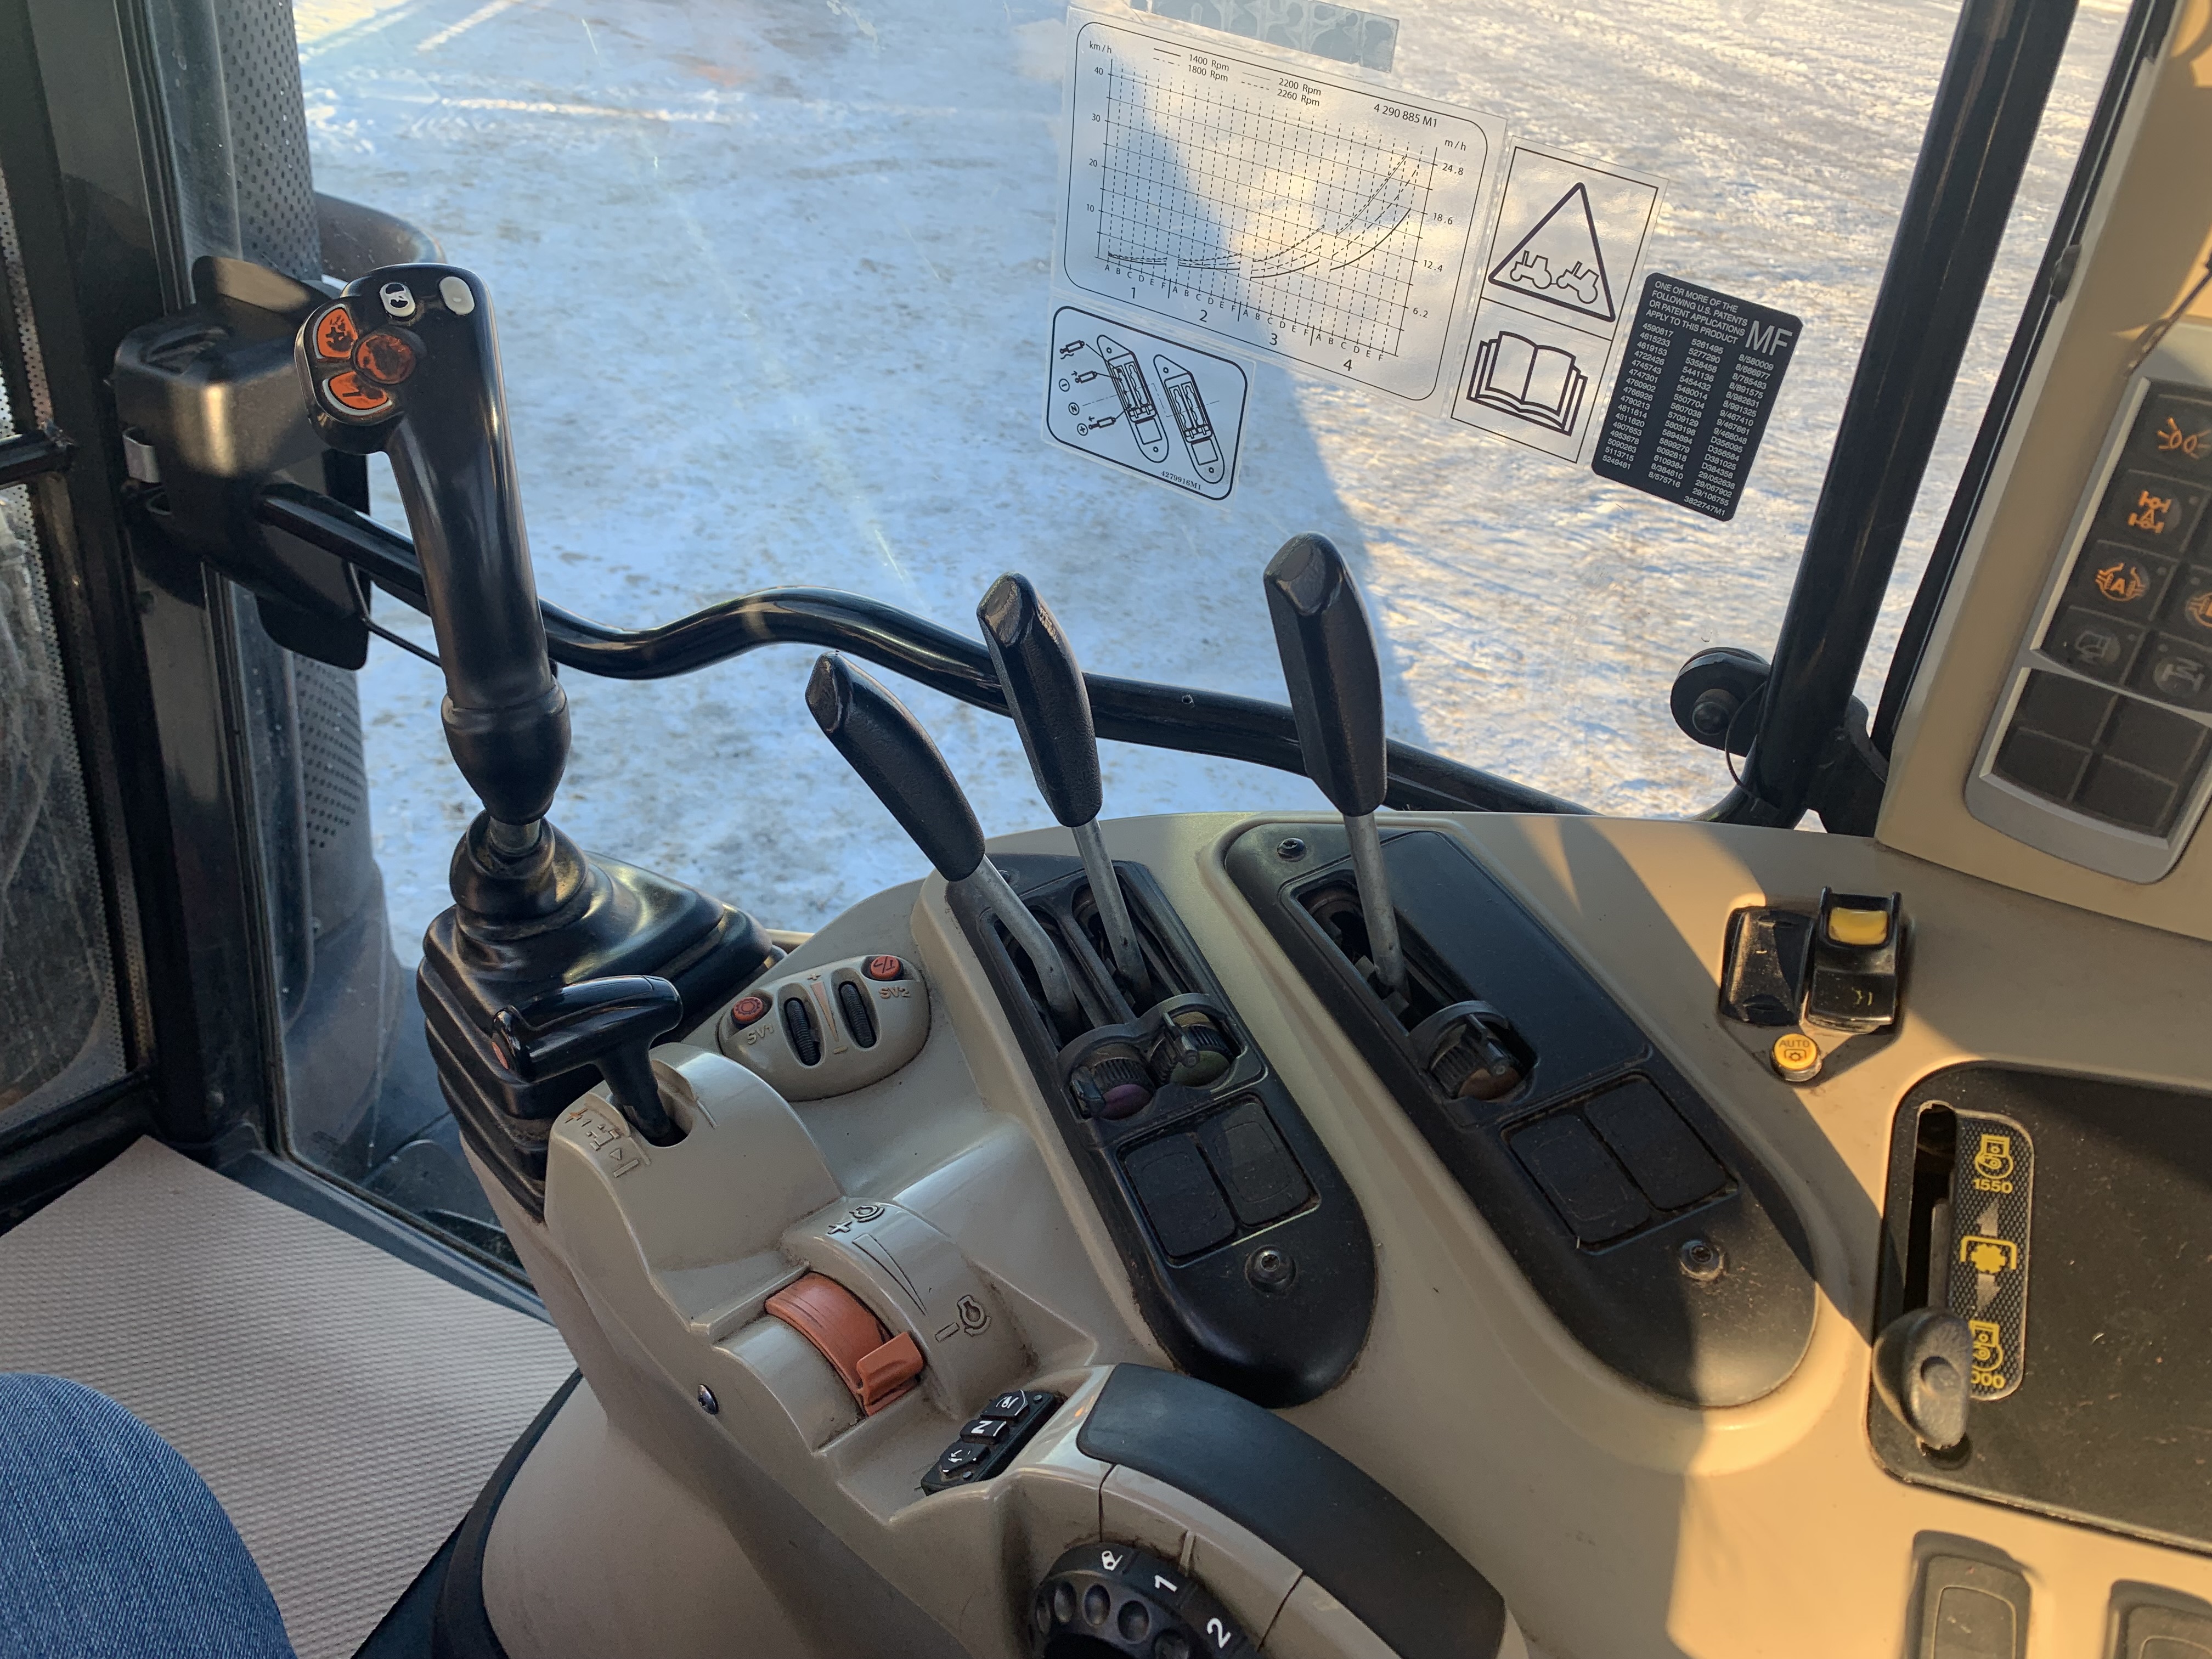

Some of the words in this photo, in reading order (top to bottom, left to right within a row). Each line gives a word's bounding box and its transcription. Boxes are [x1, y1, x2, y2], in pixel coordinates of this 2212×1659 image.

[1189, 54, 1207, 65] 1400
[1211, 60, 1229, 71] Rpm
[1094, 67, 1103, 75] 40
[1188, 65, 1206, 76] 1800
[1210, 70, 1228, 82] Rpm
[1278, 78, 1299, 89] 2200
[1302, 84, 1322, 96] Rpm
[1277, 89, 1297, 100] 2260
[1301, 94, 1320, 107] Rpm
[1092, 113, 1101, 122] 30
[1374, 104, 1380, 112] 4
[1382, 105, 1400, 117] 290
[1402, 111, 1420, 123] 885
[1423, 117, 1437, 128] M1
[1089, 159, 1097, 167] 20
[1442, 162, 1464, 176] 24.8
[1087, 204, 1094, 212] 10
[1432, 212, 1453, 225] 18.6
[1423, 259, 1443, 272] 12.4
[1655, 280, 1672, 292] ONE
[1673, 286, 1684, 296] OR
[1685, 290, 1709, 303] MORE
[1710, 298, 1722, 307] OF
[1723, 301, 1739, 313] THE
[1413, 307, 1429, 318] 6.2
[1652, 290, 1696, 311] FOLLOWING
[1697, 304, 1712, 316] U.S.
[1713, 309, 1748, 327] PATENTS
[1649, 300, 1661, 309] OR
[1661, 303, 1691, 318] PATENT
[1691, 313, 1746, 337] APPLICATIONS
[1131, 287, 1136, 298] 1
[1199, 309, 1207, 323] 2
[1269, 333, 1278, 346] 3
[1343, 359, 1353, 371] 4
[1643, 323, 1674, 337] 4590817
[1646, 309, 1668, 322] APPLY
[1670, 315, 1681, 326] TO
[1682, 320, 1699, 332] THIS
[1700, 326, 1739, 345] PRODUCT
[1640, 332, 1671, 347] 4615233
[1691, 338, 1724, 354] 5261495
[1745, 319, 1793, 357] MF
[1366, 349, 1371, 358] E
[1637, 341, 1668, 356] 4619153
[1688, 347, 1720, 364] 5277290
[1634, 350, 1665, 365] 4722426
[1685, 357, 1718, 373] 5358458
[1739, 354, 1774, 371] 8/580009
[1631, 359, 1662, 375] 4745743
[1682, 366, 1714, 382] 5441136
[1628, 368, 1658, 383] 4747301
[1679, 375, 1711, 391] 5454432
[1732, 373, 1767, 390] 8/785483
[1626, 377, 1656, 392] 4760902
[1676, 384, 1708, 400] 5480014
[1729, 382, 1764, 399] 8/891575
[1623, 386, 1654, 402] 4766926
[1673, 393, 1705, 409] 5507704
[1725, 391, 1760, 408] 8/982631
[1070, 404, 1077, 413] N
[1620, 395, 1650, 410] 4790213
[1670, 402, 1702, 419] 5607038
[1617, 404, 1647, 419] 4811614
[1667, 411, 1699, 427] 5709129
[1719, 409, 1754, 426] 9/467410
[1612, 421, 1642, 436] 4907653
[1716, 419, 1750, 436] 9/467661
[1607, 438, 1637, 453] 5090263
[1610, 430, 1639, 445] 4953678
[1659, 437, 1690, 453] 5899279
[1711, 436, 1743, 453] D356095
[1605, 447, 1634, 461] 5113715
[1656, 446, 1687, 462] 6092818
[1707, 444, 1740, 462] D356584
[1654, 454, 1684, 470] 6109384
[1704, 453, 1737, 471] D381025
[1701, 462, 1734, 479] D384358
[1160, 471, 1201, 490] 4279916M1
[1648, 471, 1681, 488] 8/575716
[1698, 471, 1736, 490] 29/052638
[1695, 479, 1733, 498] 29/067902
[1684, 495, 1726, 516] 3822747M1
[1692, 488, 1730, 507] 29/106755
[879, 985, 911, 1000] SV2
[747, 1024, 774, 1045] SV1
[1779, 1040, 1810, 1048] AUTO
[1971, 1178, 2013, 1194] 1550
[1971, 1370, 2006, 1389] 000
[970, 1420, 993, 1434] N
[1154, 1573, 1178, 1592] 1
[1206, 1617, 1232, 1648] 2
